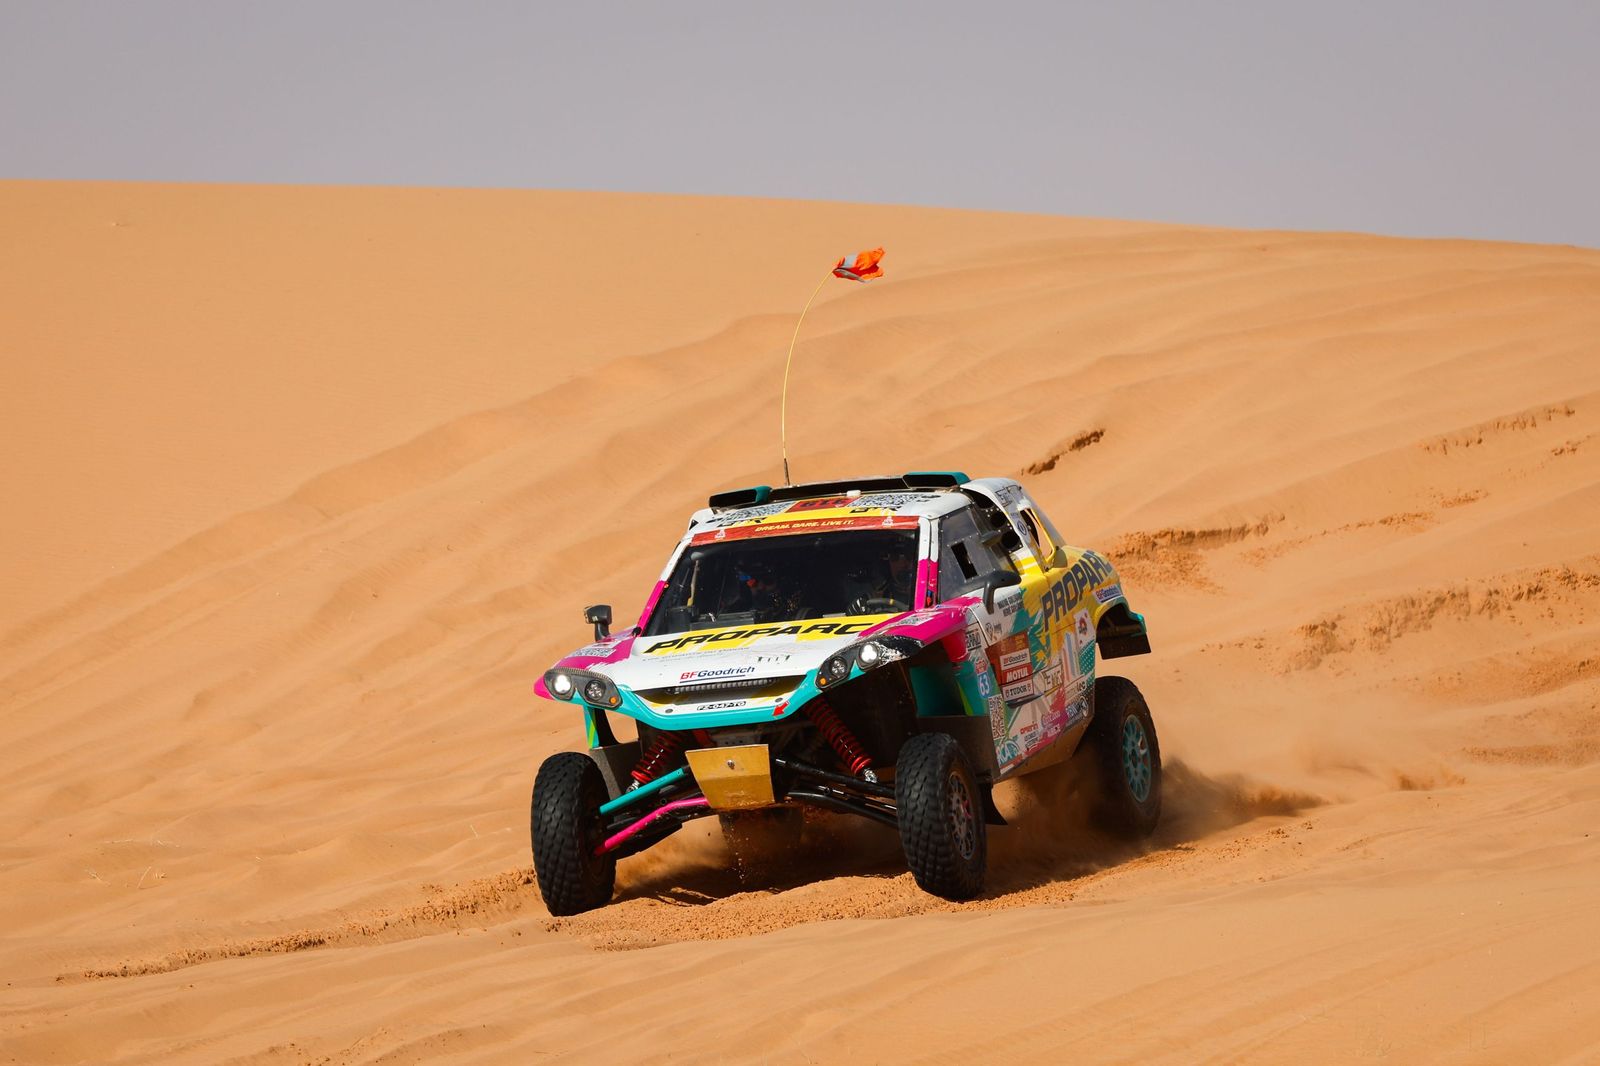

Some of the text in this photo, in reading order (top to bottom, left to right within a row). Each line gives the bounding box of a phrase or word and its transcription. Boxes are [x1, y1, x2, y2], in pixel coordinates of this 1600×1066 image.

[755, 524, 790, 532] DREAM.
[645, 623, 875, 653] PROPARC
[680, 666, 756, 680] BFGoodrich
[1006, 667, 1028, 682] MOTUL
[1009, 685, 1027, 696] TUDOR
